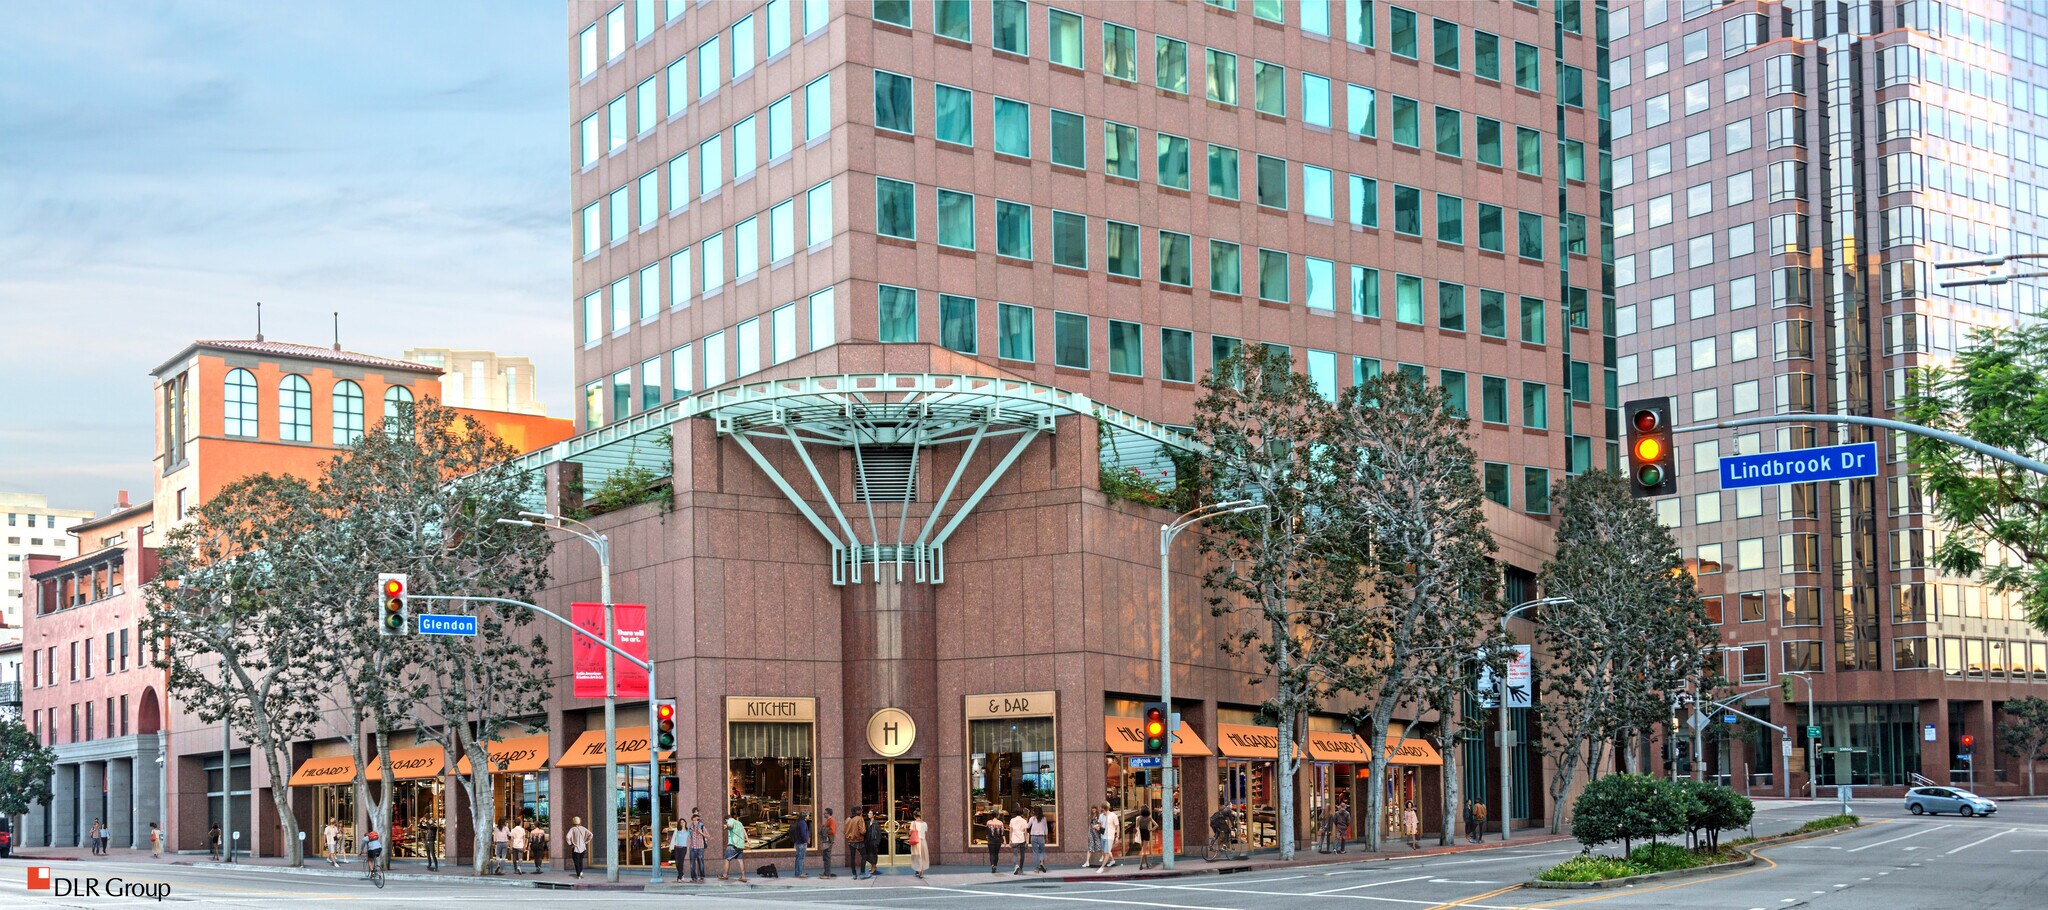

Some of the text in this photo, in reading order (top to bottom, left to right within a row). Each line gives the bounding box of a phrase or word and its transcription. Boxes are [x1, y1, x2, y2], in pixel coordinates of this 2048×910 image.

[1730, 452, 1866, 480] Lindbrook Dr
[423, 619, 473, 631] Glendon
[747, 701, 797, 716] KITCHEN
[989, 698, 1030, 712] & BAR
[883, 721, 899, 746] H
[1312, 739, 1364, 754] HILGARD'S
[302, 766, 350, 777] HILGARD'S
